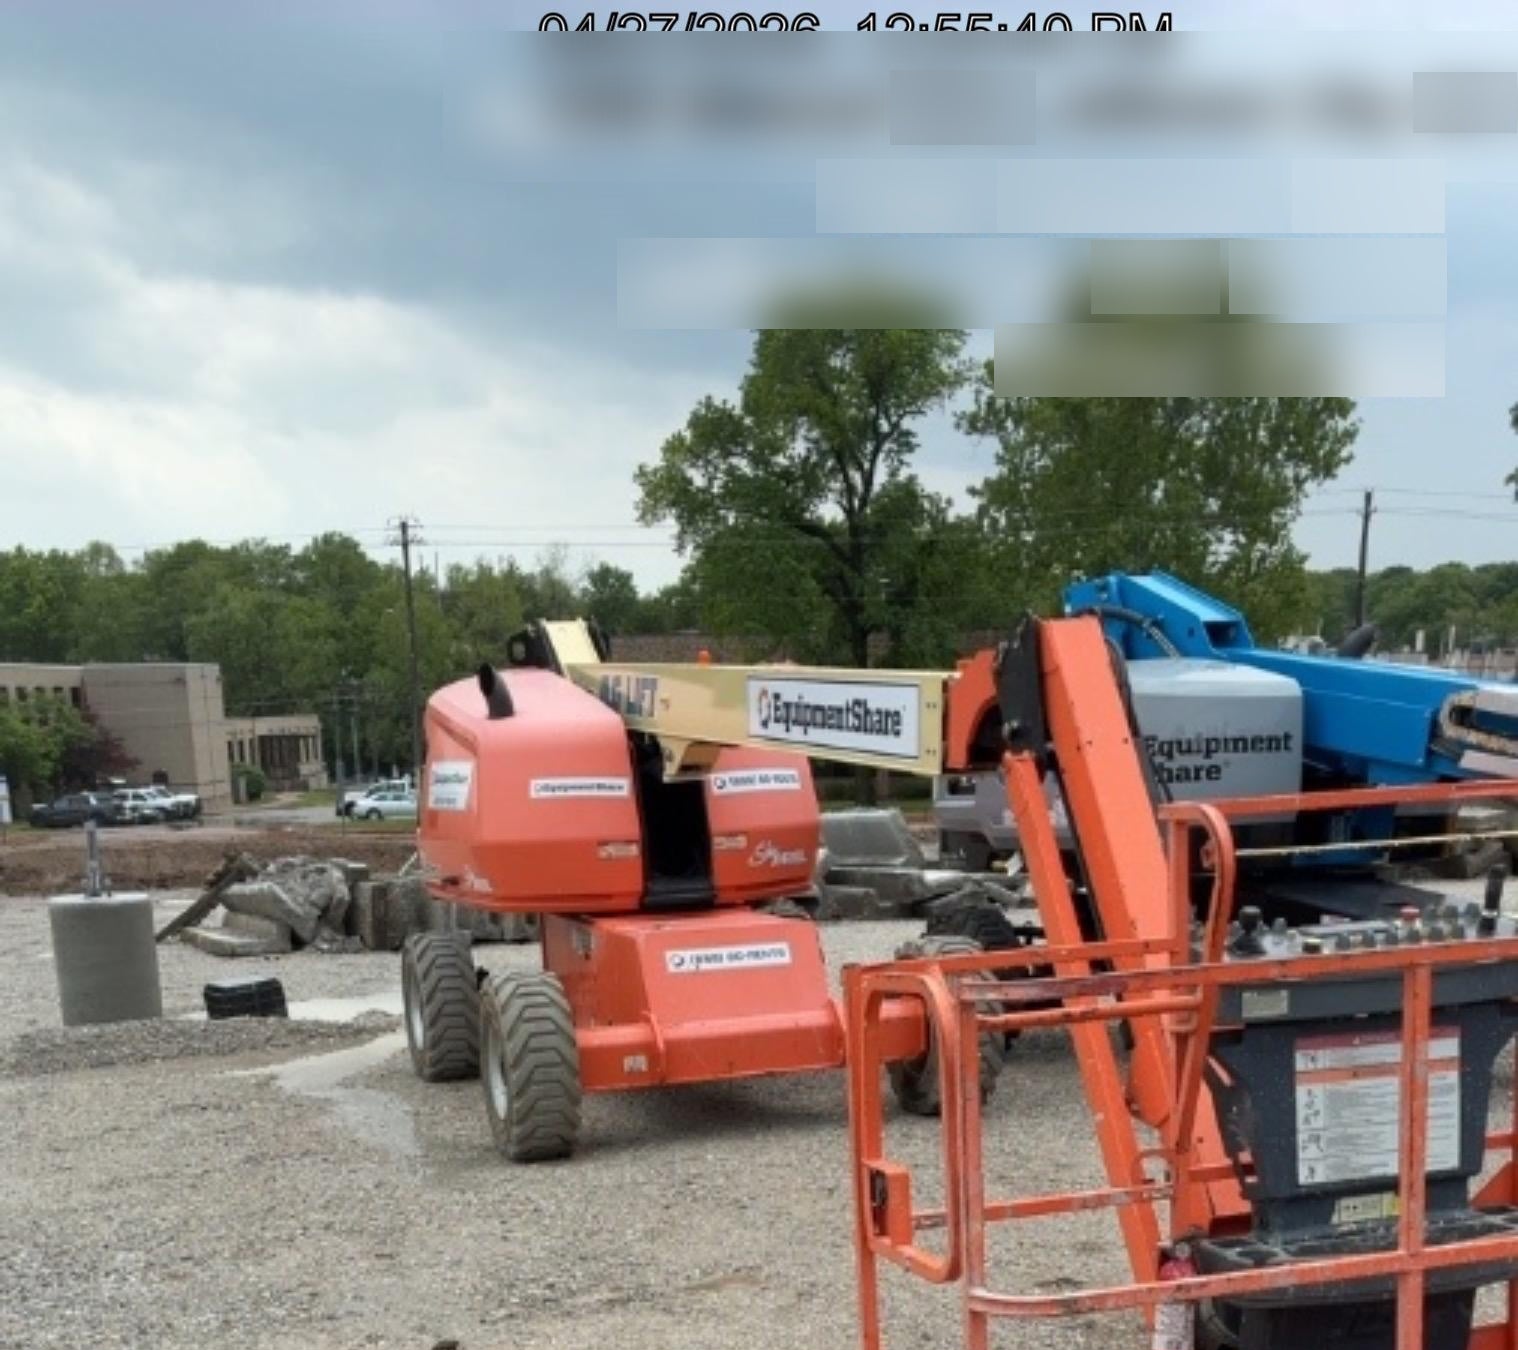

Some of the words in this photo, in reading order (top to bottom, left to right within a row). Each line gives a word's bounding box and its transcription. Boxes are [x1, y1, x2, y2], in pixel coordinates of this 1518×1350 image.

[773, 692, 902, 738] EquipmentShare
[1143, 731, 1294, 760] Equipment
[1155, 761, 1222, 784] hare
